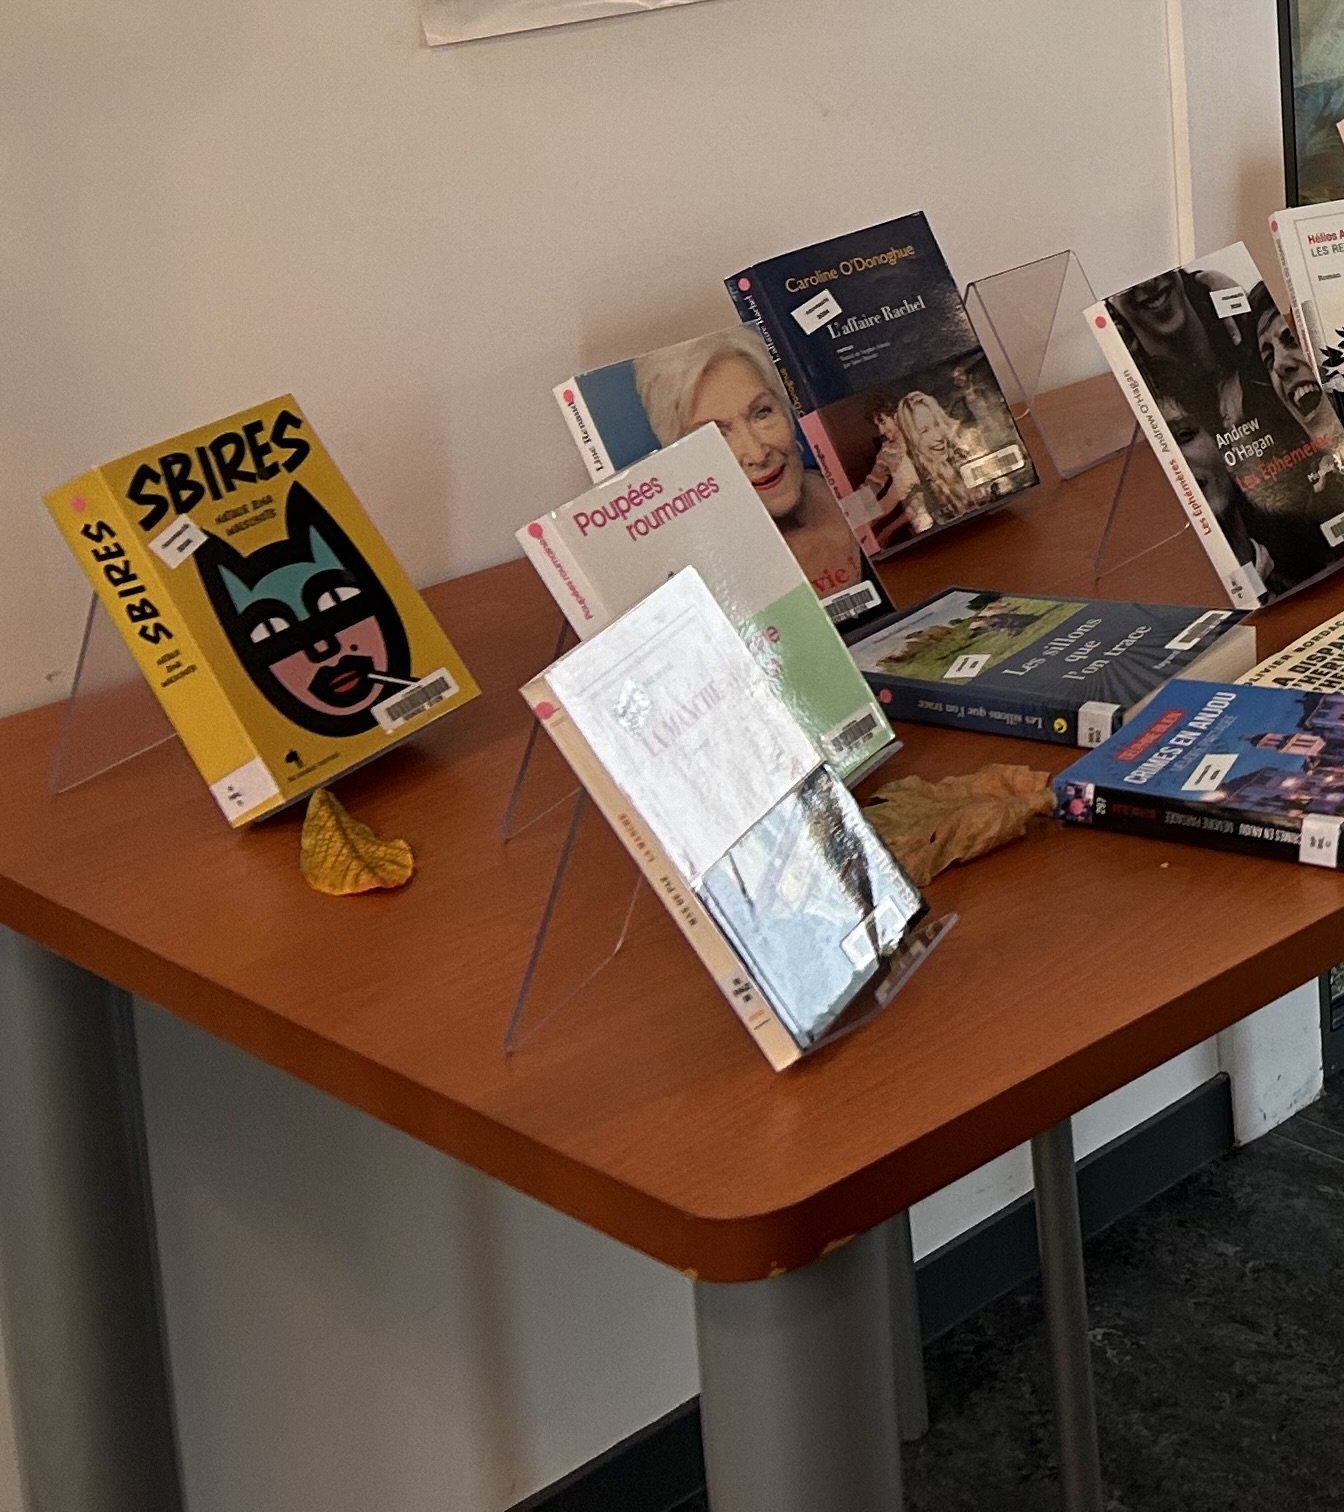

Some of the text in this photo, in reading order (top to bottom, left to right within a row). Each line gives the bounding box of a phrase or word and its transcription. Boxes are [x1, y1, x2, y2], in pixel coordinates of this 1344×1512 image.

[1307, 230, 1339, 246] Hélios
[1310, 244, 1331, 259] LES
[785, 244, 916, 294] Caroline O'Donoghue
[825, 294, 928, 340] L'affaire Rachel
[1122, 368, 1171, 454] Andrew O'Hagan
[1215, 415, 1261, 450] Andrew
[124, 408, 311, 533] SBIRES
[1223, 431, 1276, 469] O'Hagan
[573, 475, 665, 537] Poupées
[625, 475, 721, 542] roumaines
[1168, 458, 1214, 536] Les Éphémères
[79, 518, 175, 645] SBIRES
[538, 536, 574, 583] roumaine
[1001, 615, 1104, 677] Les sillons
[1061, 624, 1153, 682] l'on trace
[1064, 639, 1103, 665] que
[918, 699, 1044, 730] Les sillons que l'on trace
[1122, 745, 1185, 785] CRIMES
[1176, 726, 1204, 748] EN
[1192, 690, 1238, 737] ANJOU
